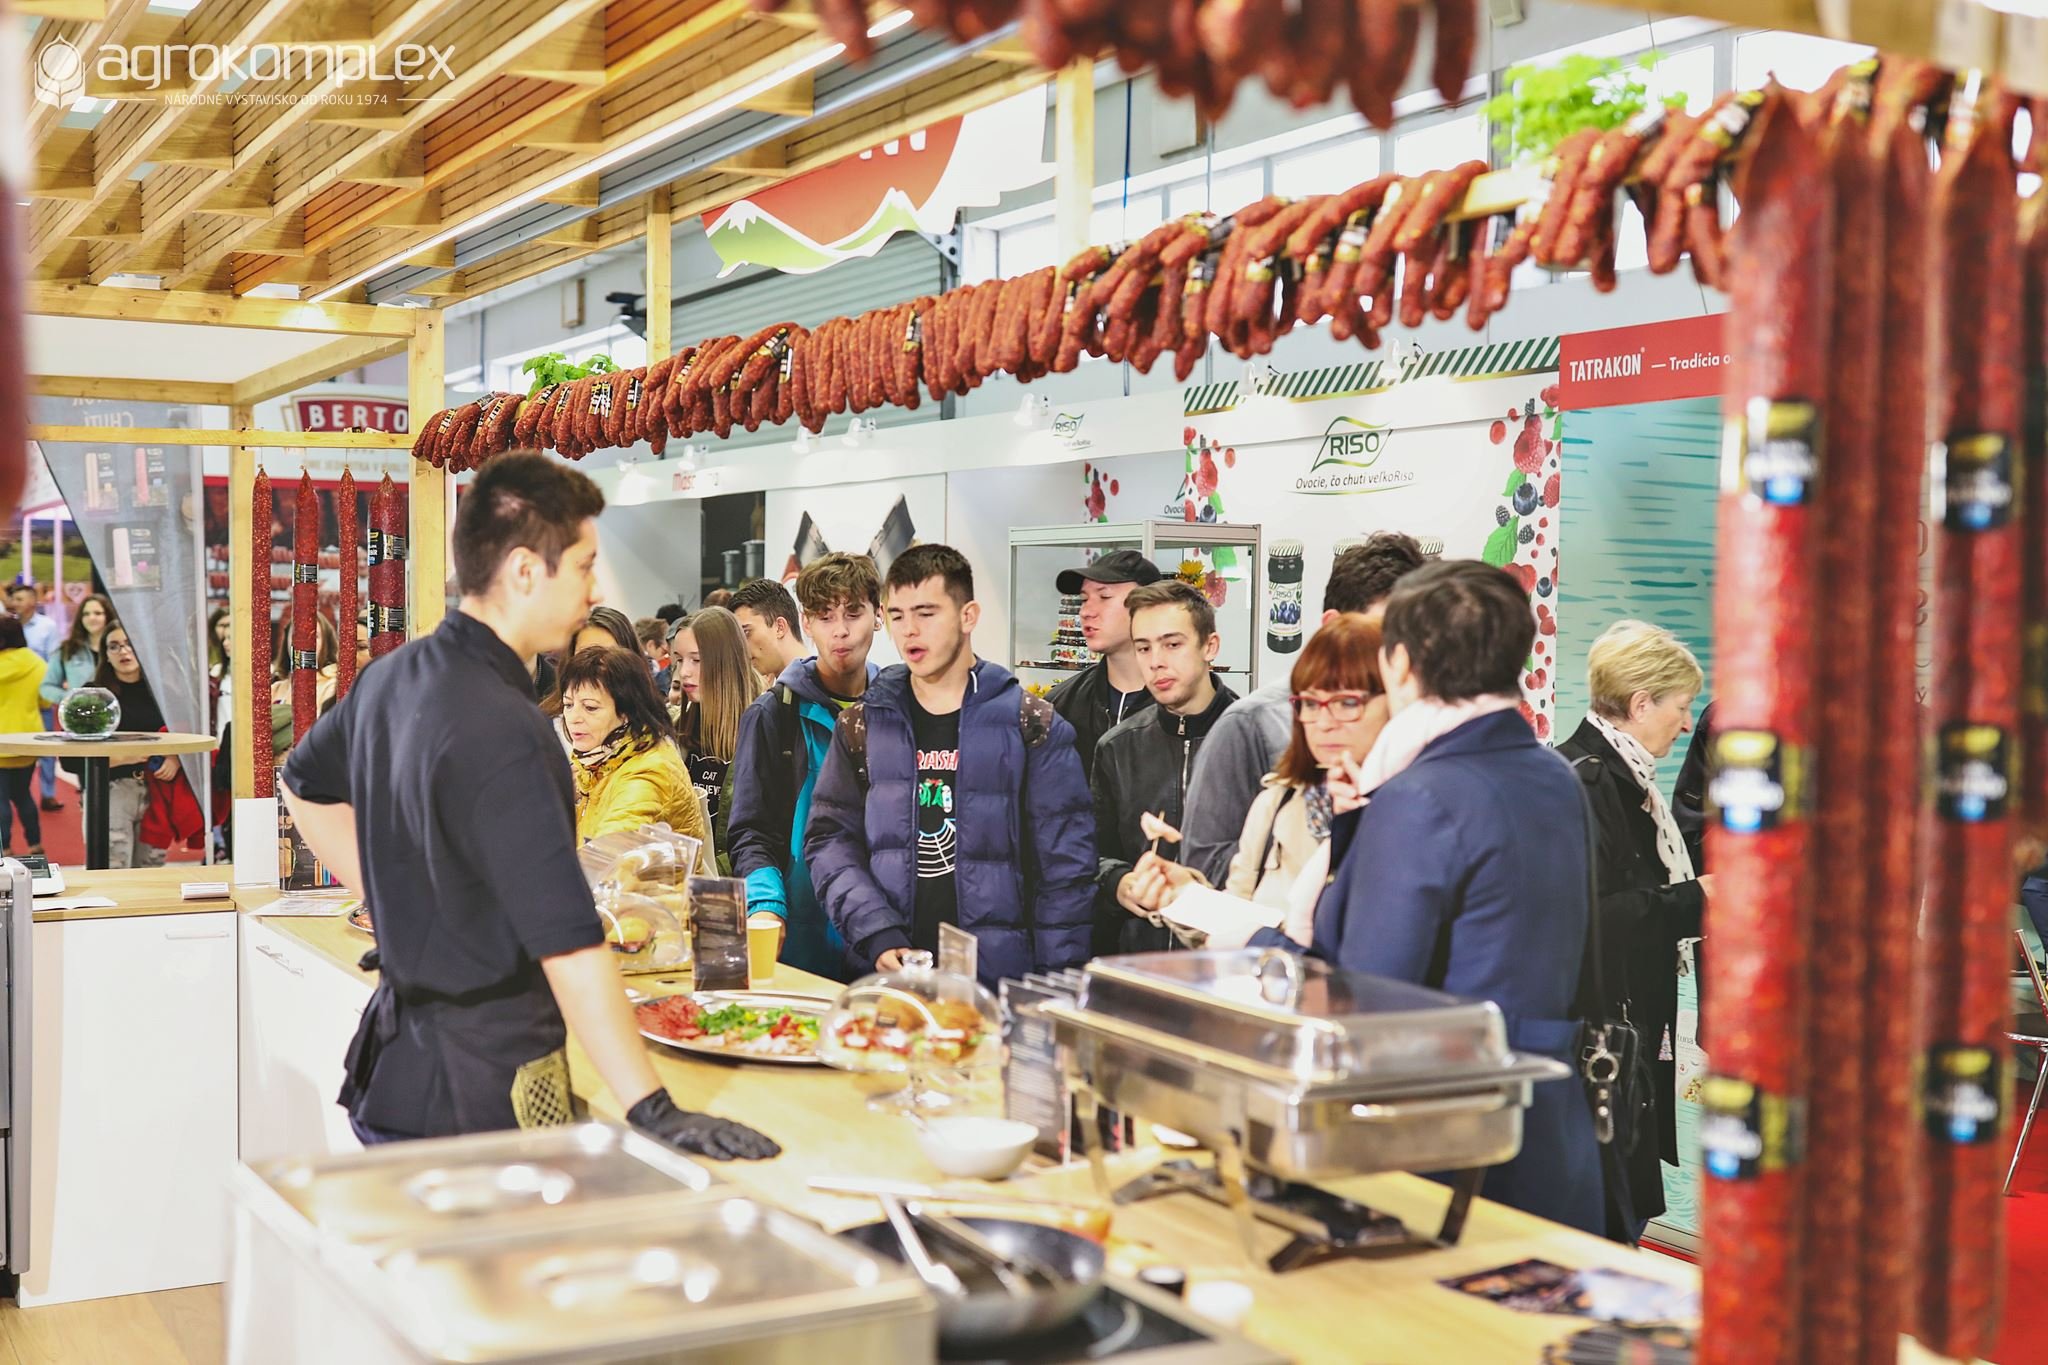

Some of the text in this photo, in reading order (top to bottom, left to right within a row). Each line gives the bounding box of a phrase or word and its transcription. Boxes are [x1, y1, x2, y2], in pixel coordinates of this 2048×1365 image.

[1669, 351, 1720, 371] Tradícia
[308, 403, 409, 433] BERTO
[1329, 431, 1380, 456] RISO
[1295, 477, 1329, 490] Ovocie,
[1330, 474, 1341, 487] čo
[701, 770, 718, 781] CAT
